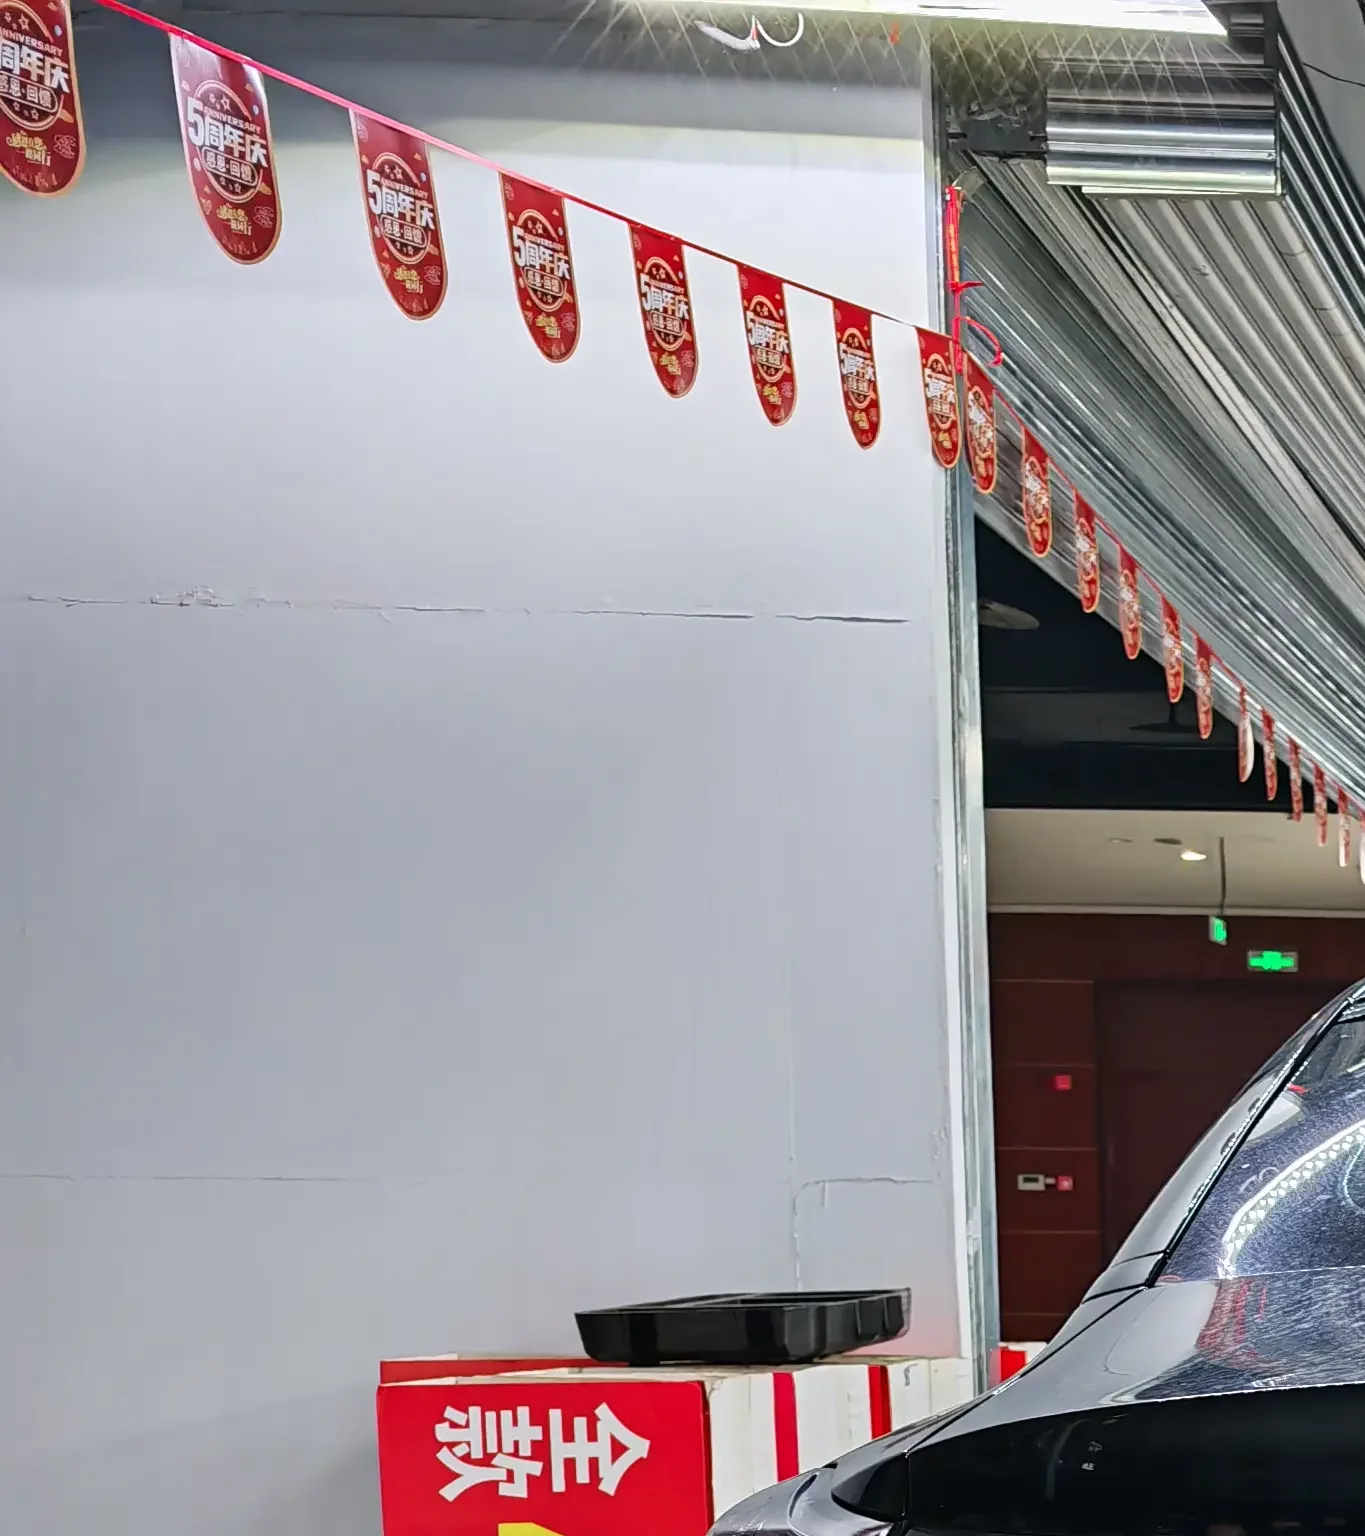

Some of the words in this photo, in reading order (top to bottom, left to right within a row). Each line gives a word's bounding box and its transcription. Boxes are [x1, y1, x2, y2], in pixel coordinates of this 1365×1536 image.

[187, 97, 268, 168] 5周年庆
[366, 169, 435, 230] 5周年庆
[512, 225, 570, 279] 5周年庆
[434, 1402, 650, 1502] 全款
